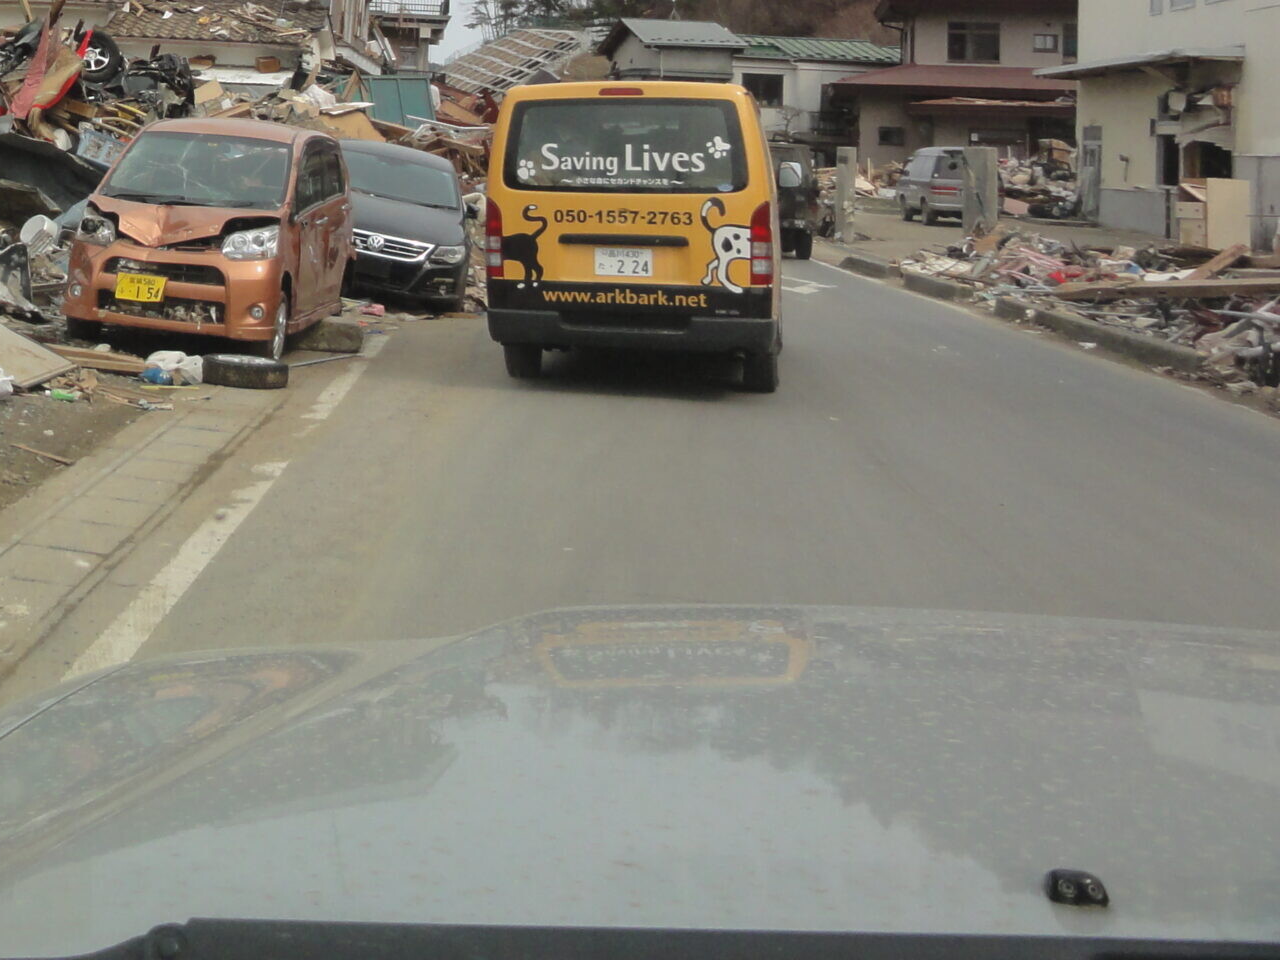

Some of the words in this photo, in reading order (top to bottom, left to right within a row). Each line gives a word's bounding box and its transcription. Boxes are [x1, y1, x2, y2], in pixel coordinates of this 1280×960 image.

[541, 143, 618, 175] Saving
[625, 144, 705, 172] Lives
[554, 209, 693, 225] 050-1557-2763
[543, 289, 708, 308] www.arkbark.net
